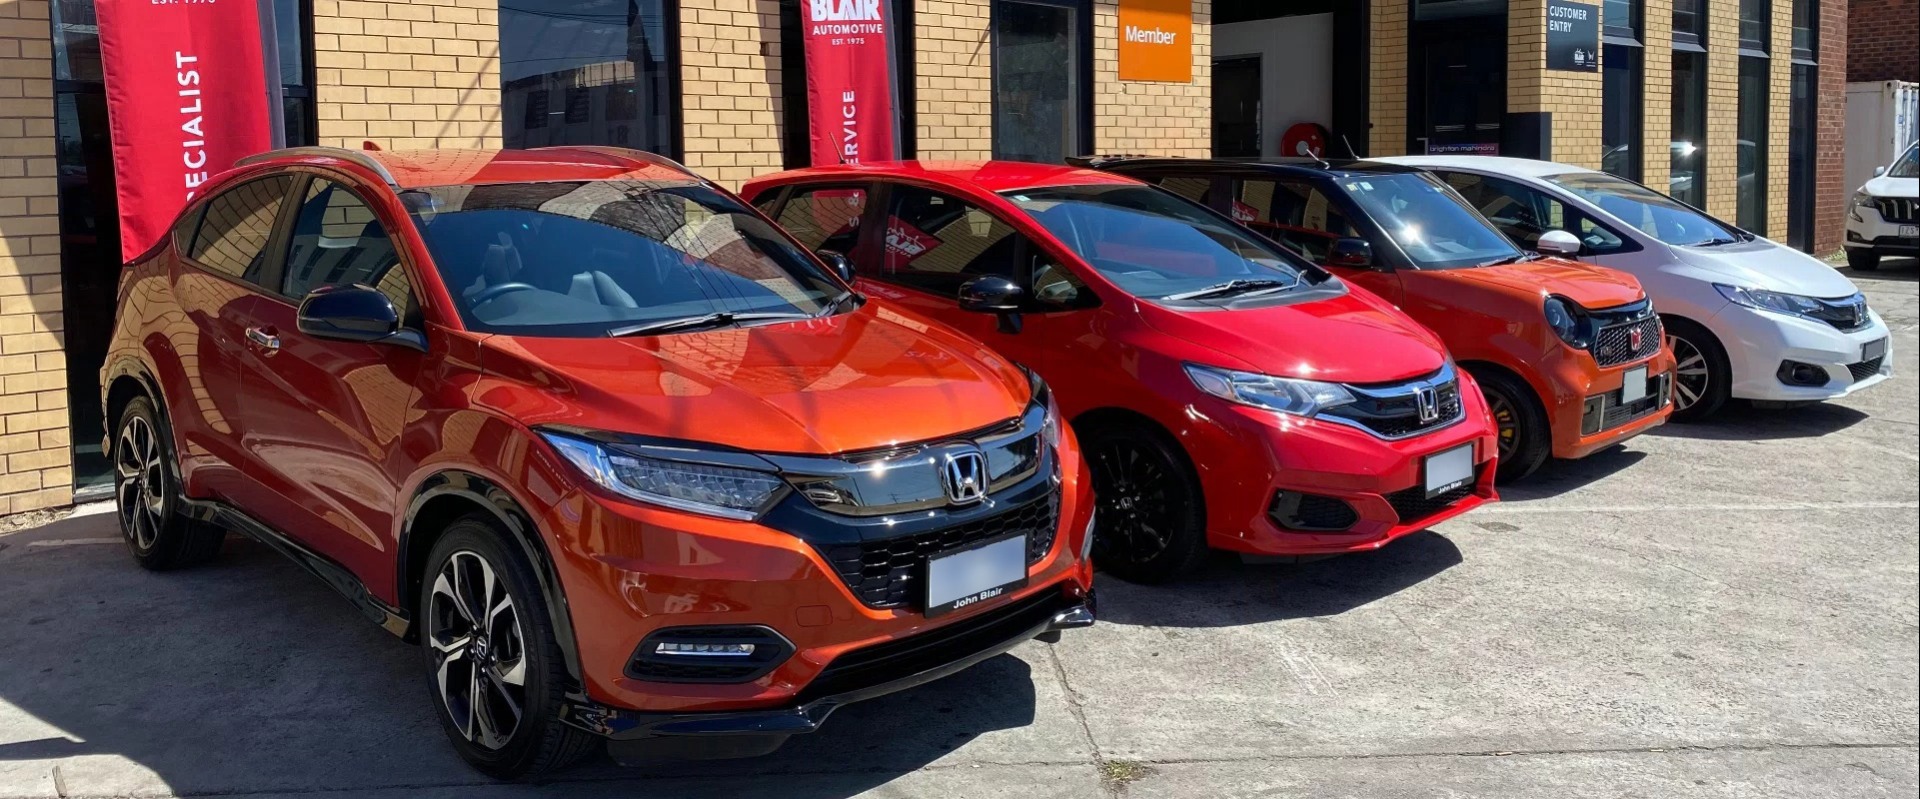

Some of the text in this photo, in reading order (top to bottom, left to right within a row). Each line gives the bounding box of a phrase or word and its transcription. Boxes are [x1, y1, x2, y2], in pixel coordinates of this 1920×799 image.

[810, 0, 881, 21] BLAIR
[1550, 5, 1587, 20] CUSTOMER
[812, 23, 883, 35] AUTOMOTIVE
[1125, 25, 1176, 45] Member
[1550, 20, 1572, 32] ENTRY
[847, 37, 865, 45] 1975
[176, 51, 207, 202] ECIALIST
[843, 90, 859, 164] ERVICE
[953, 587, 1003, 609] John Blair
